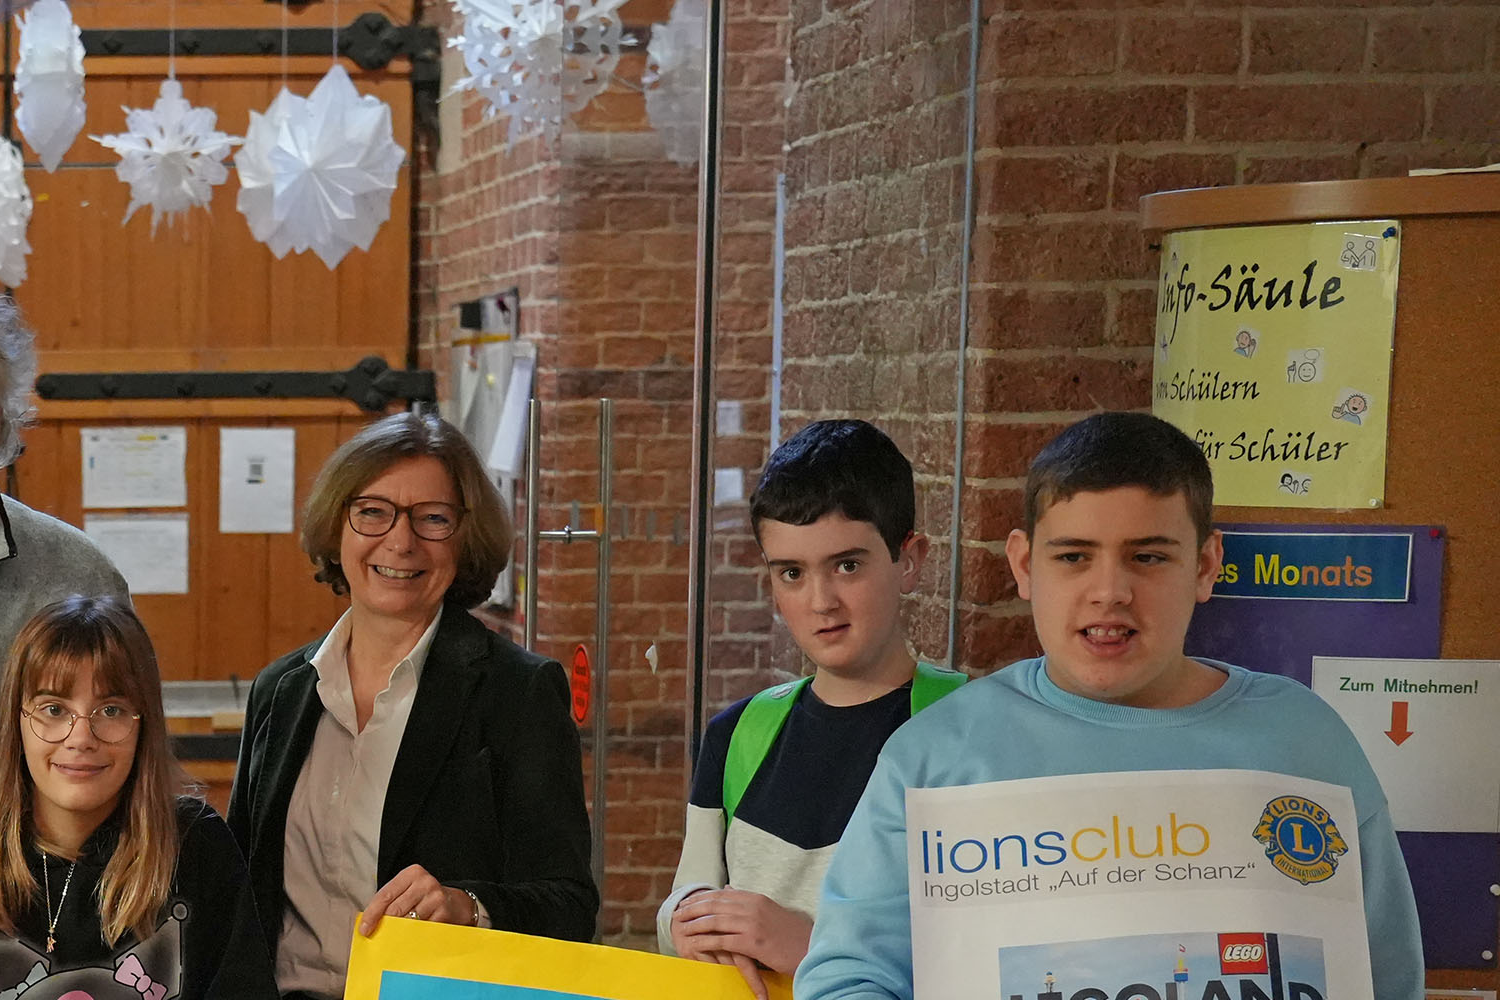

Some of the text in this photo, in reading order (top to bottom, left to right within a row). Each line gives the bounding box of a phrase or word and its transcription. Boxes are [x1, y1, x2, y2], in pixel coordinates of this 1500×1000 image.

[1162, 260, 1345, 344] Info-Säule
[1170, 368, 1260, 401] Schülern
[1229, 428, 1349, 462] Schüler
[1254, 554, 1373, 586] Monats
[1339, 677, 1479, 694] Zum Mitnehmen!
[1272, 800, 1325, 822] LIONS
[922, 813, 1210, 875] lionsclub
[924, 874, 1039, 902] Ingolstadt
[1049, 867, 1098, 892] „Auf
[1107, 866, 1146, 884] der
[1277, 858, 1329, 878] INTERNATIONAL
[1224, 944, 1264, 962] LEGO
